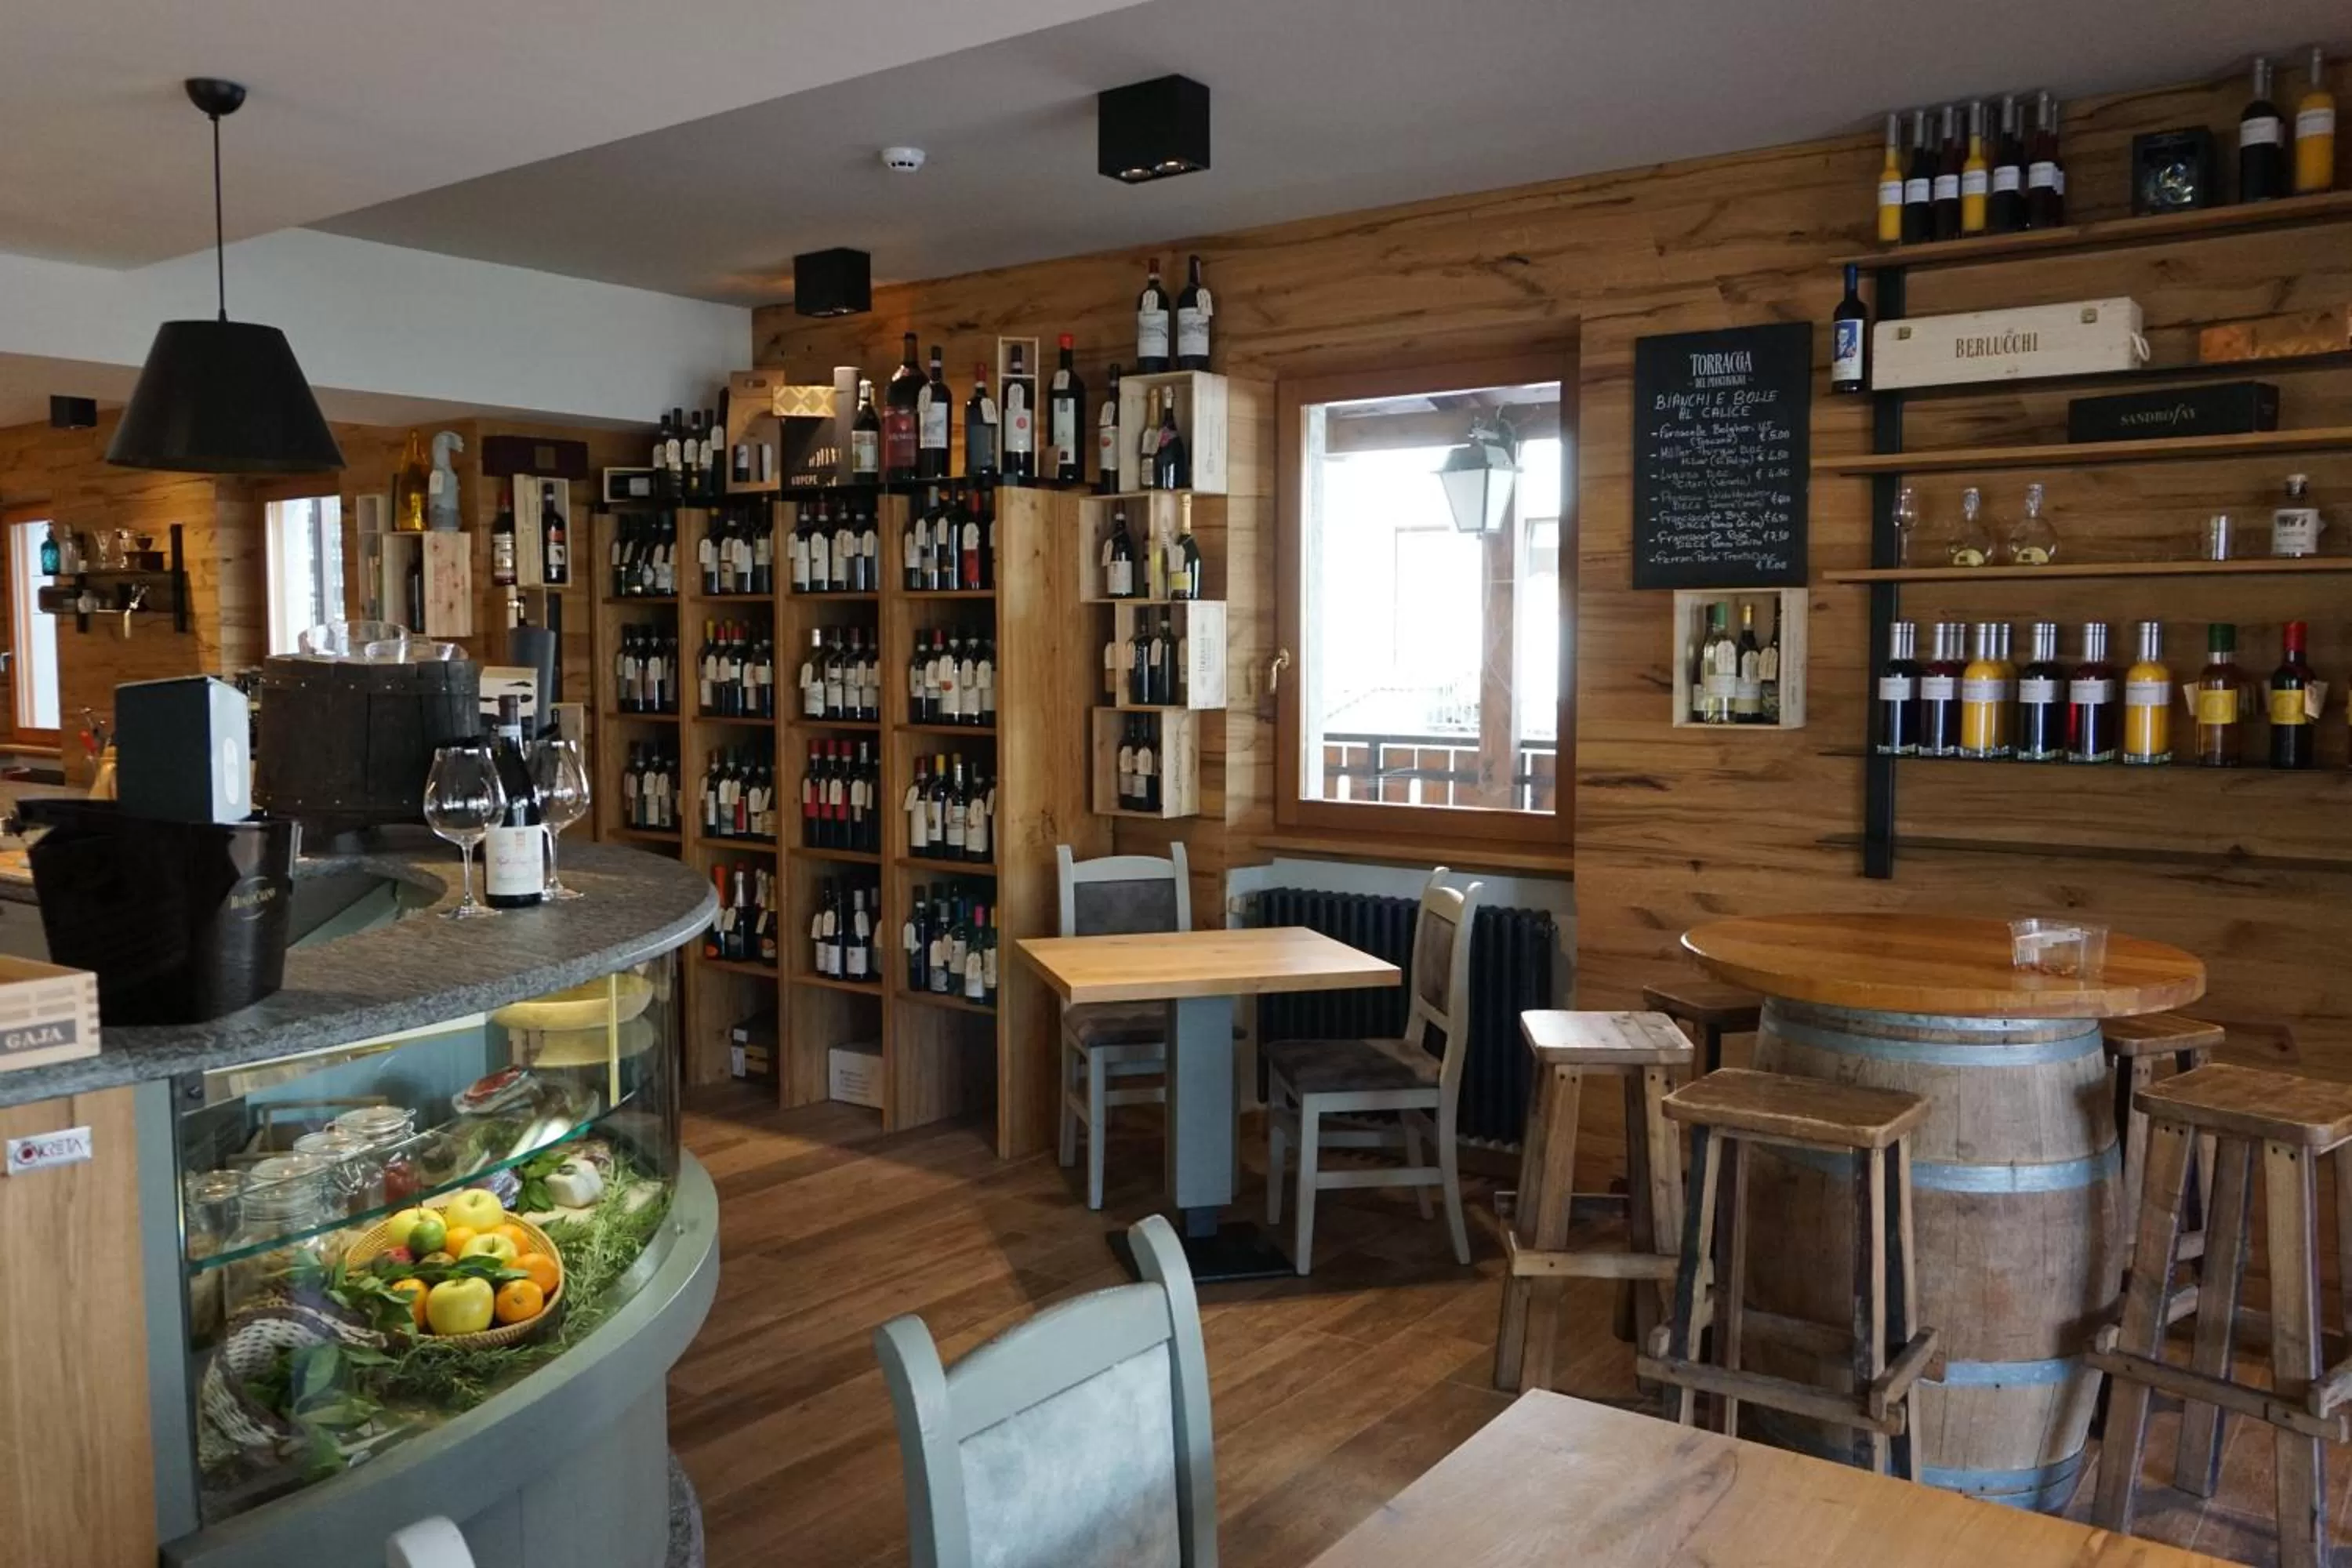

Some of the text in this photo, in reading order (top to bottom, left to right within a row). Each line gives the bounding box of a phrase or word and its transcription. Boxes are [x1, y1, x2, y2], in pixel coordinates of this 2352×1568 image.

[1955, 331, 2038, 358] BERLUCCHI
[1655, 390, 1780, 411] BIANCHI E BOLLE
[1678, 405, 1751, 421] AL CALICE
[5, 1025, 64, 1049] GAJA
